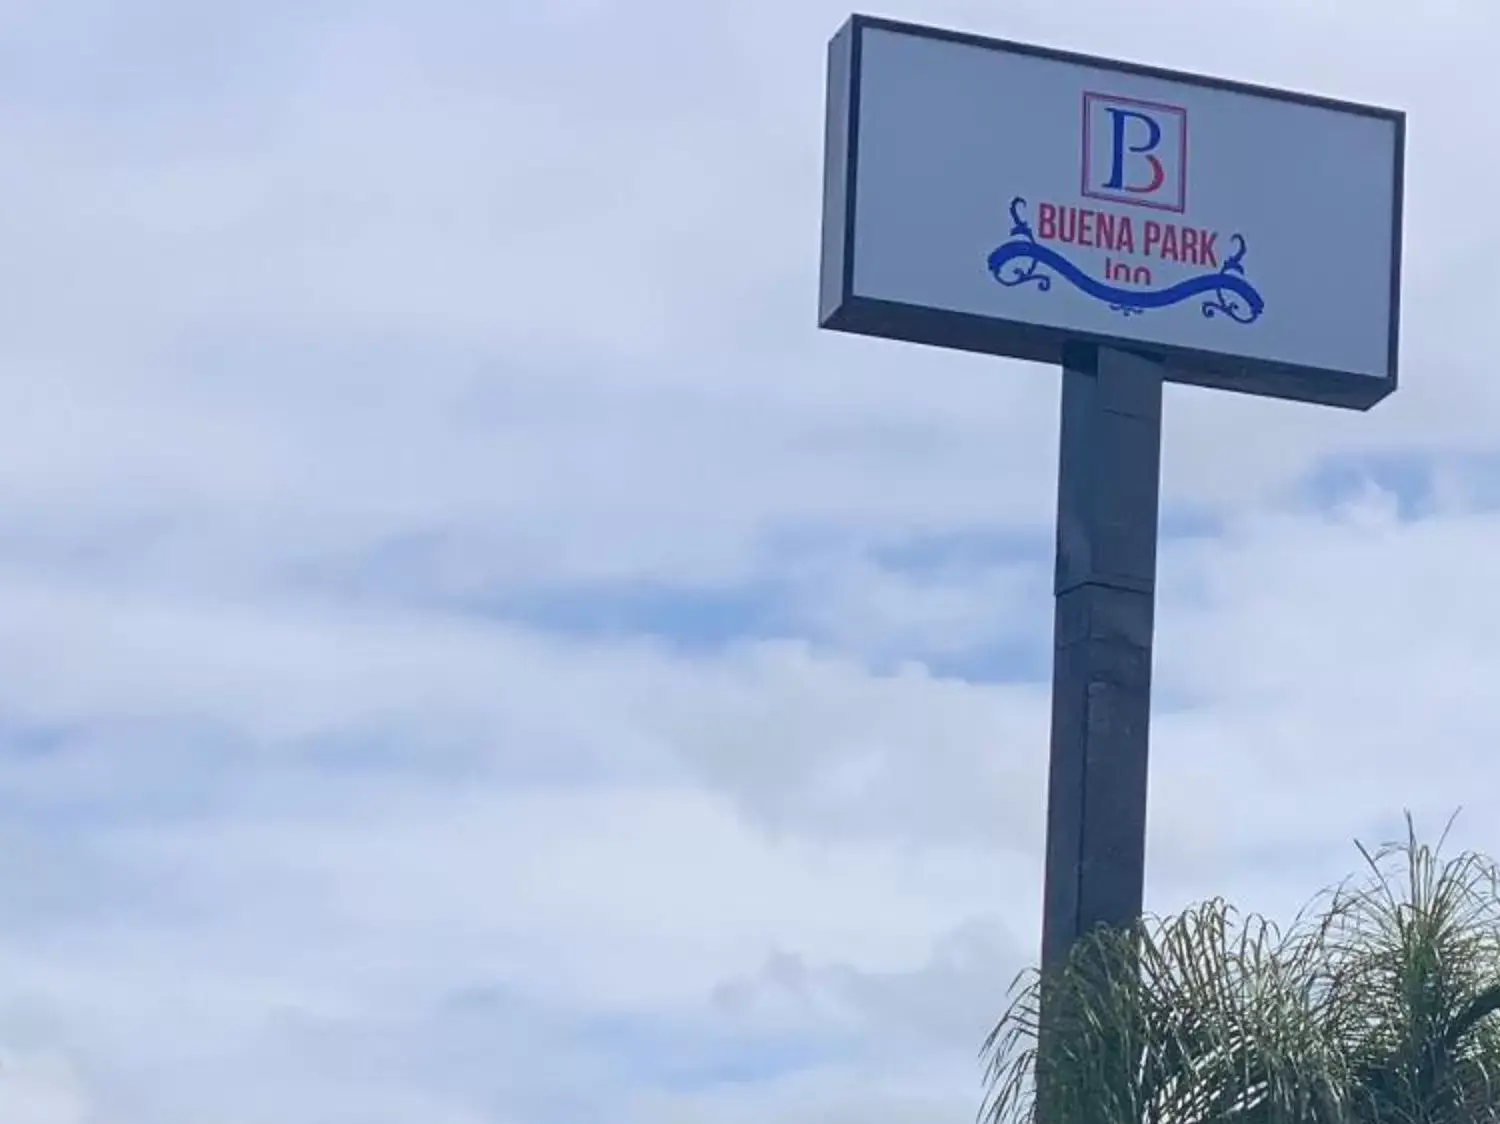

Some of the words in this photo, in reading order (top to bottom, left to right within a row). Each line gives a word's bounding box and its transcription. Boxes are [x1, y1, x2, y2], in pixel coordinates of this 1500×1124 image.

[1101, 106, 1165, 193] B
[1037, 202, 1135, 254] BUENA
[1143, 219, 1219, 268] PARK
